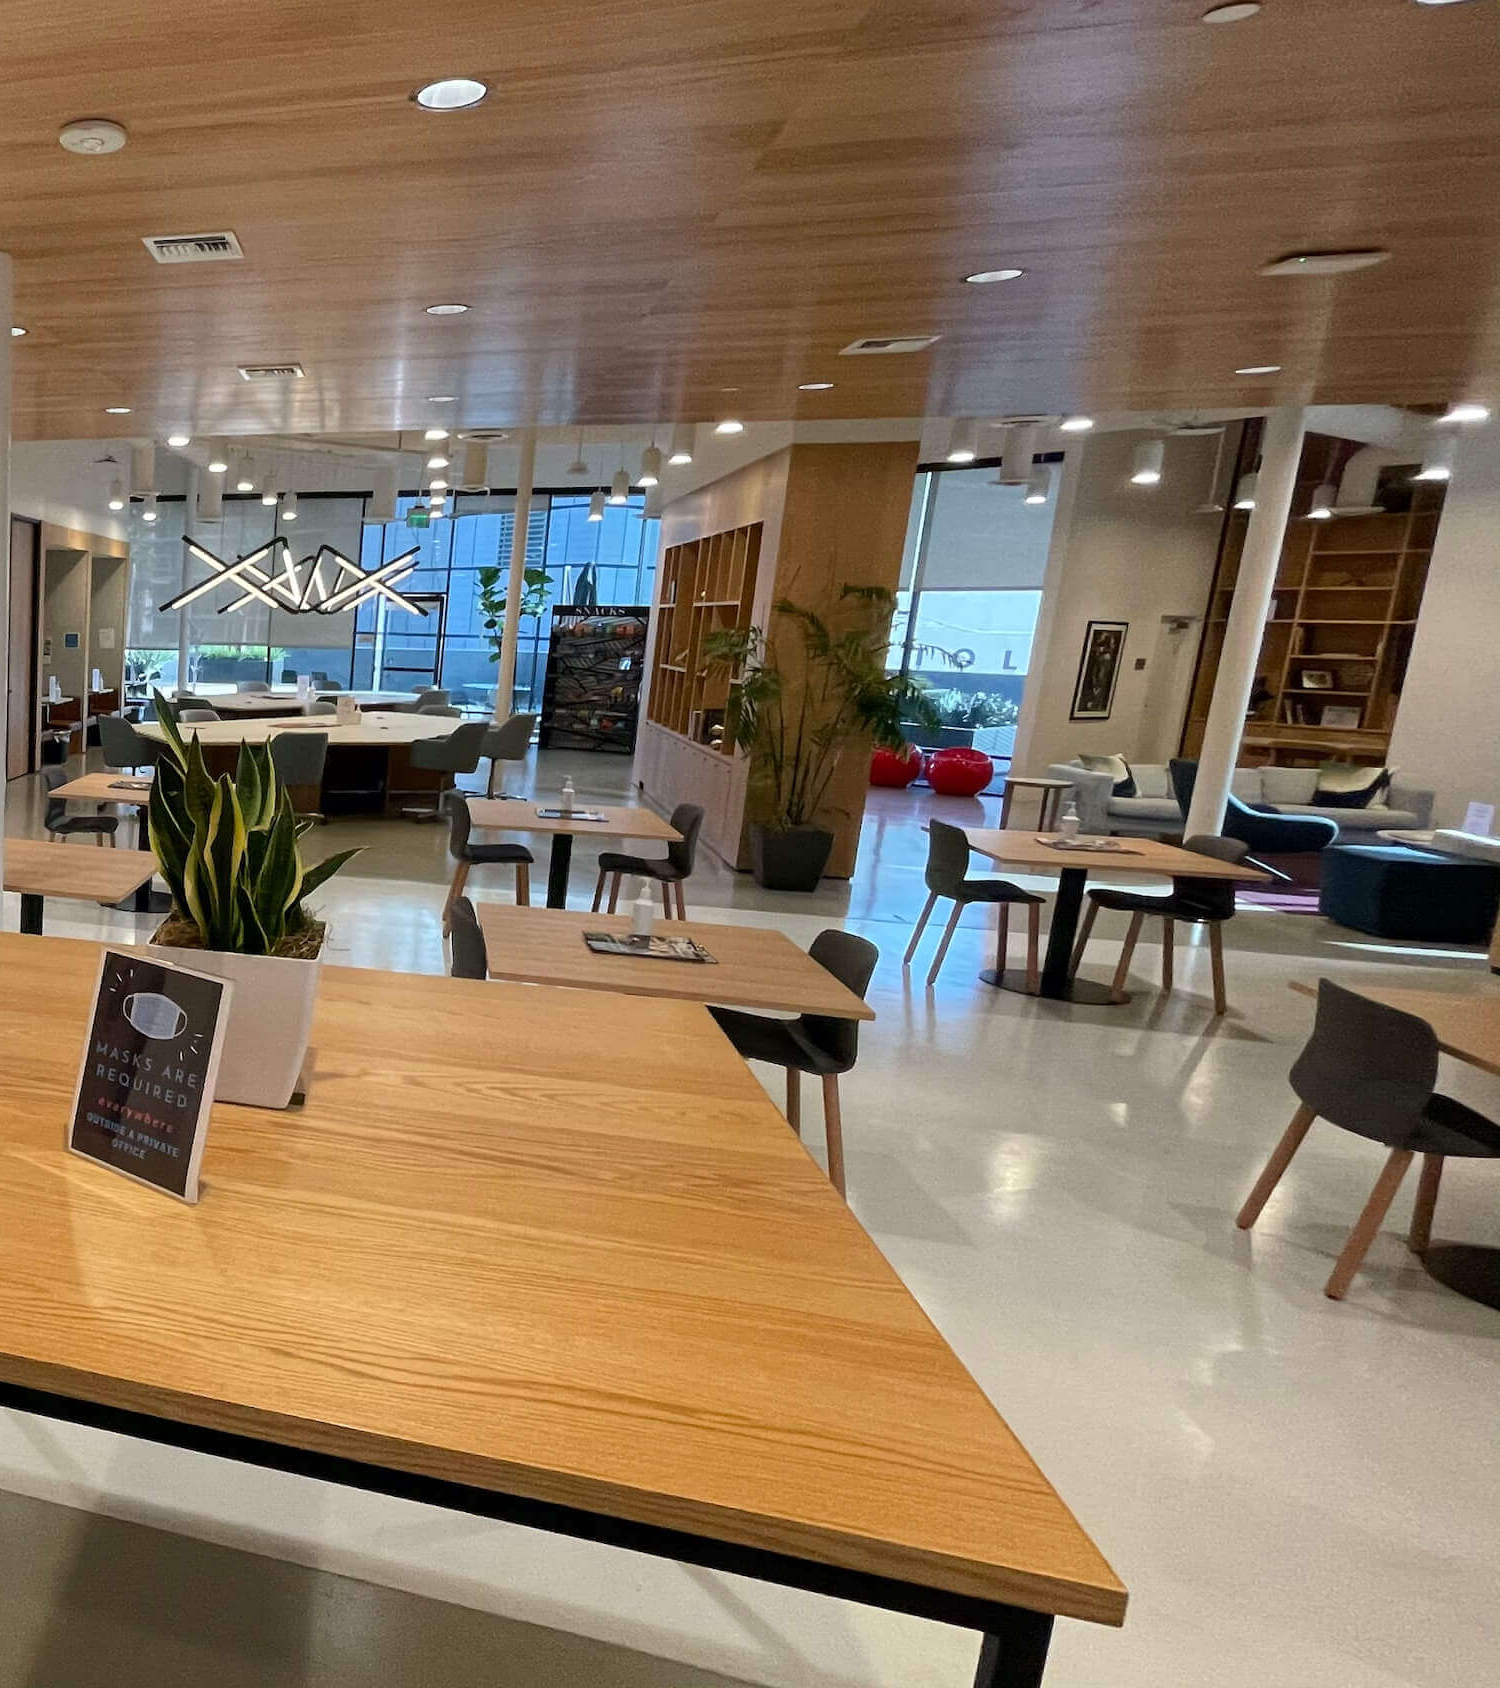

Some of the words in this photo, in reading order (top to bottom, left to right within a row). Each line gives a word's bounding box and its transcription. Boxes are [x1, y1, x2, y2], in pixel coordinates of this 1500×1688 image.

[575, 607, 626, 616] SNACKS
[96, 1041, 153, 1071] MASKS
[163, 1066, 197, 1088] ARE
[96, 1064, 187, 1108] REQUIRED
[87, 1112, 125, 1136] OUTSIDE
[128, 1129, 135, 1140] A
[137, 1133, 180, 1158] PRIVATE
[98, 1097, 173, 1133] everywhere
[112, 1138, 147, 1159] OFFICE
